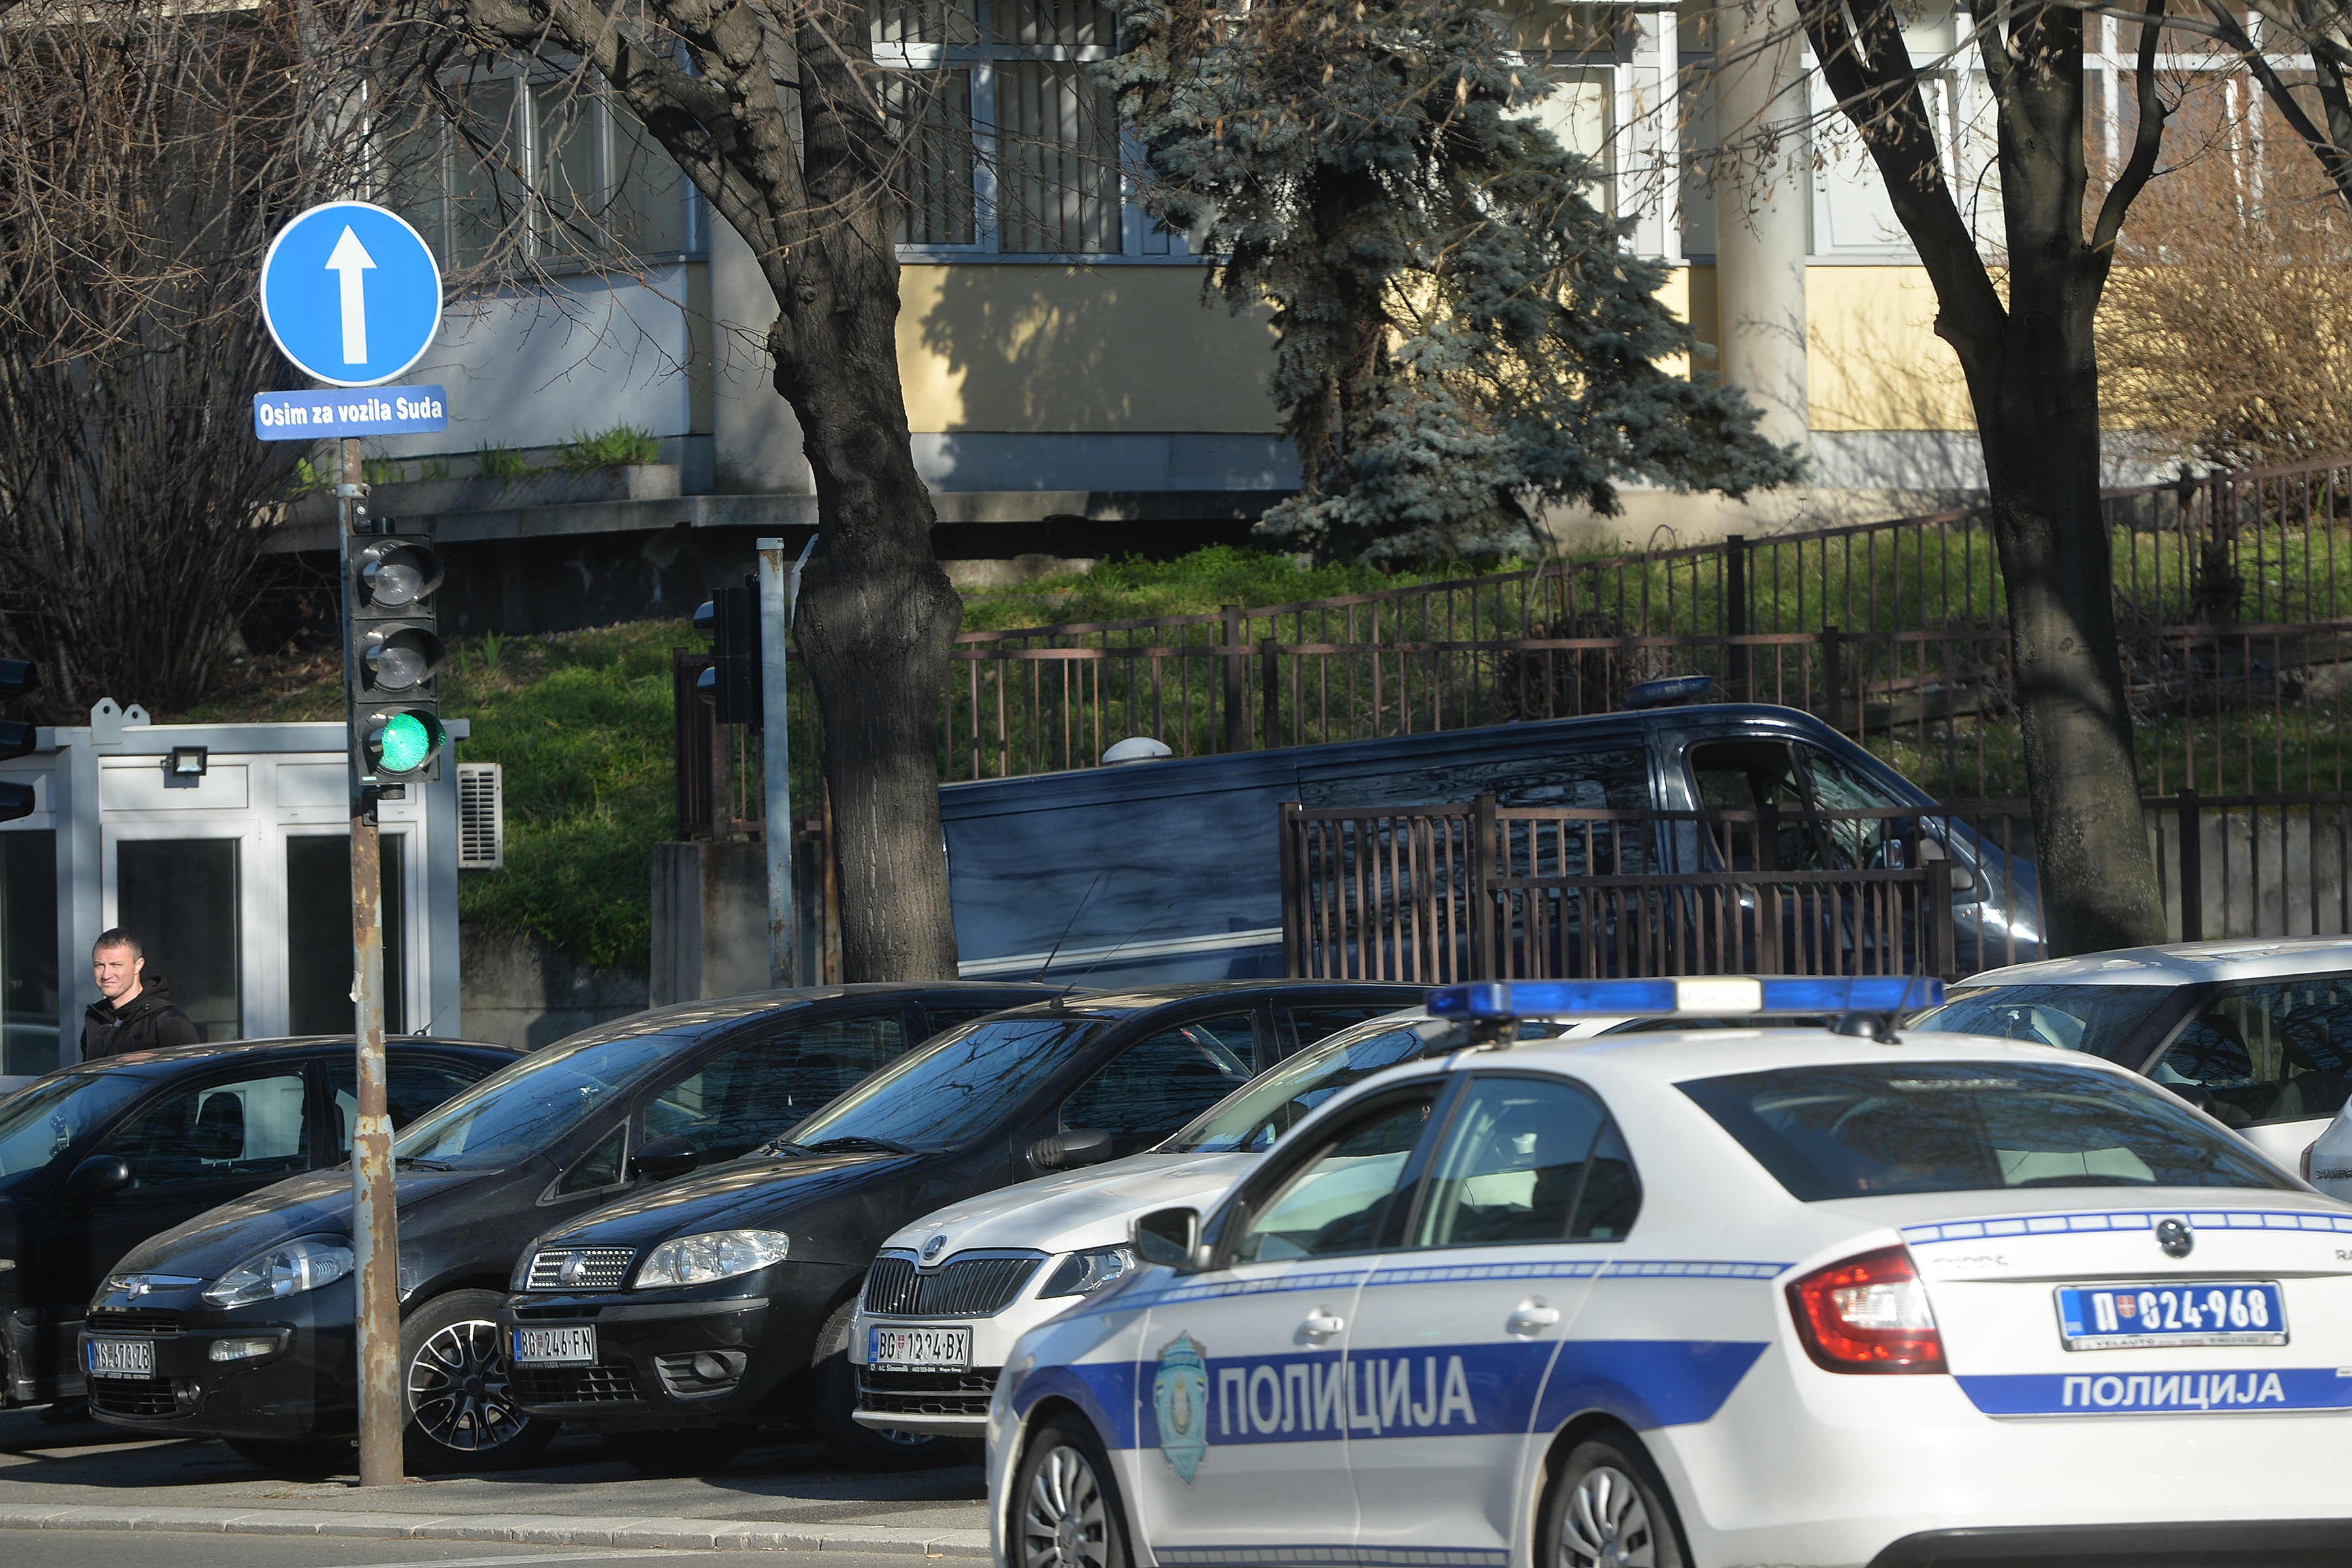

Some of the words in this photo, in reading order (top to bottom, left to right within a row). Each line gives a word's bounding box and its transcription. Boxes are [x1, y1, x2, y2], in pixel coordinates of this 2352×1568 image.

[259, 402, 308, 427] Osim
[312, 404, 335, 424] za
[337, 398, 392, 423] vozila
[396, 396, 443, 420] Suda
[521, 1331, 537, 1356] BG
[879, 1332, 896, 1359] BG
[1219, 1356, 1477, 1435] ПОЛИЦИЈА
[2063, 1373, 2285, 1410] ПОЛИЦИЈА
